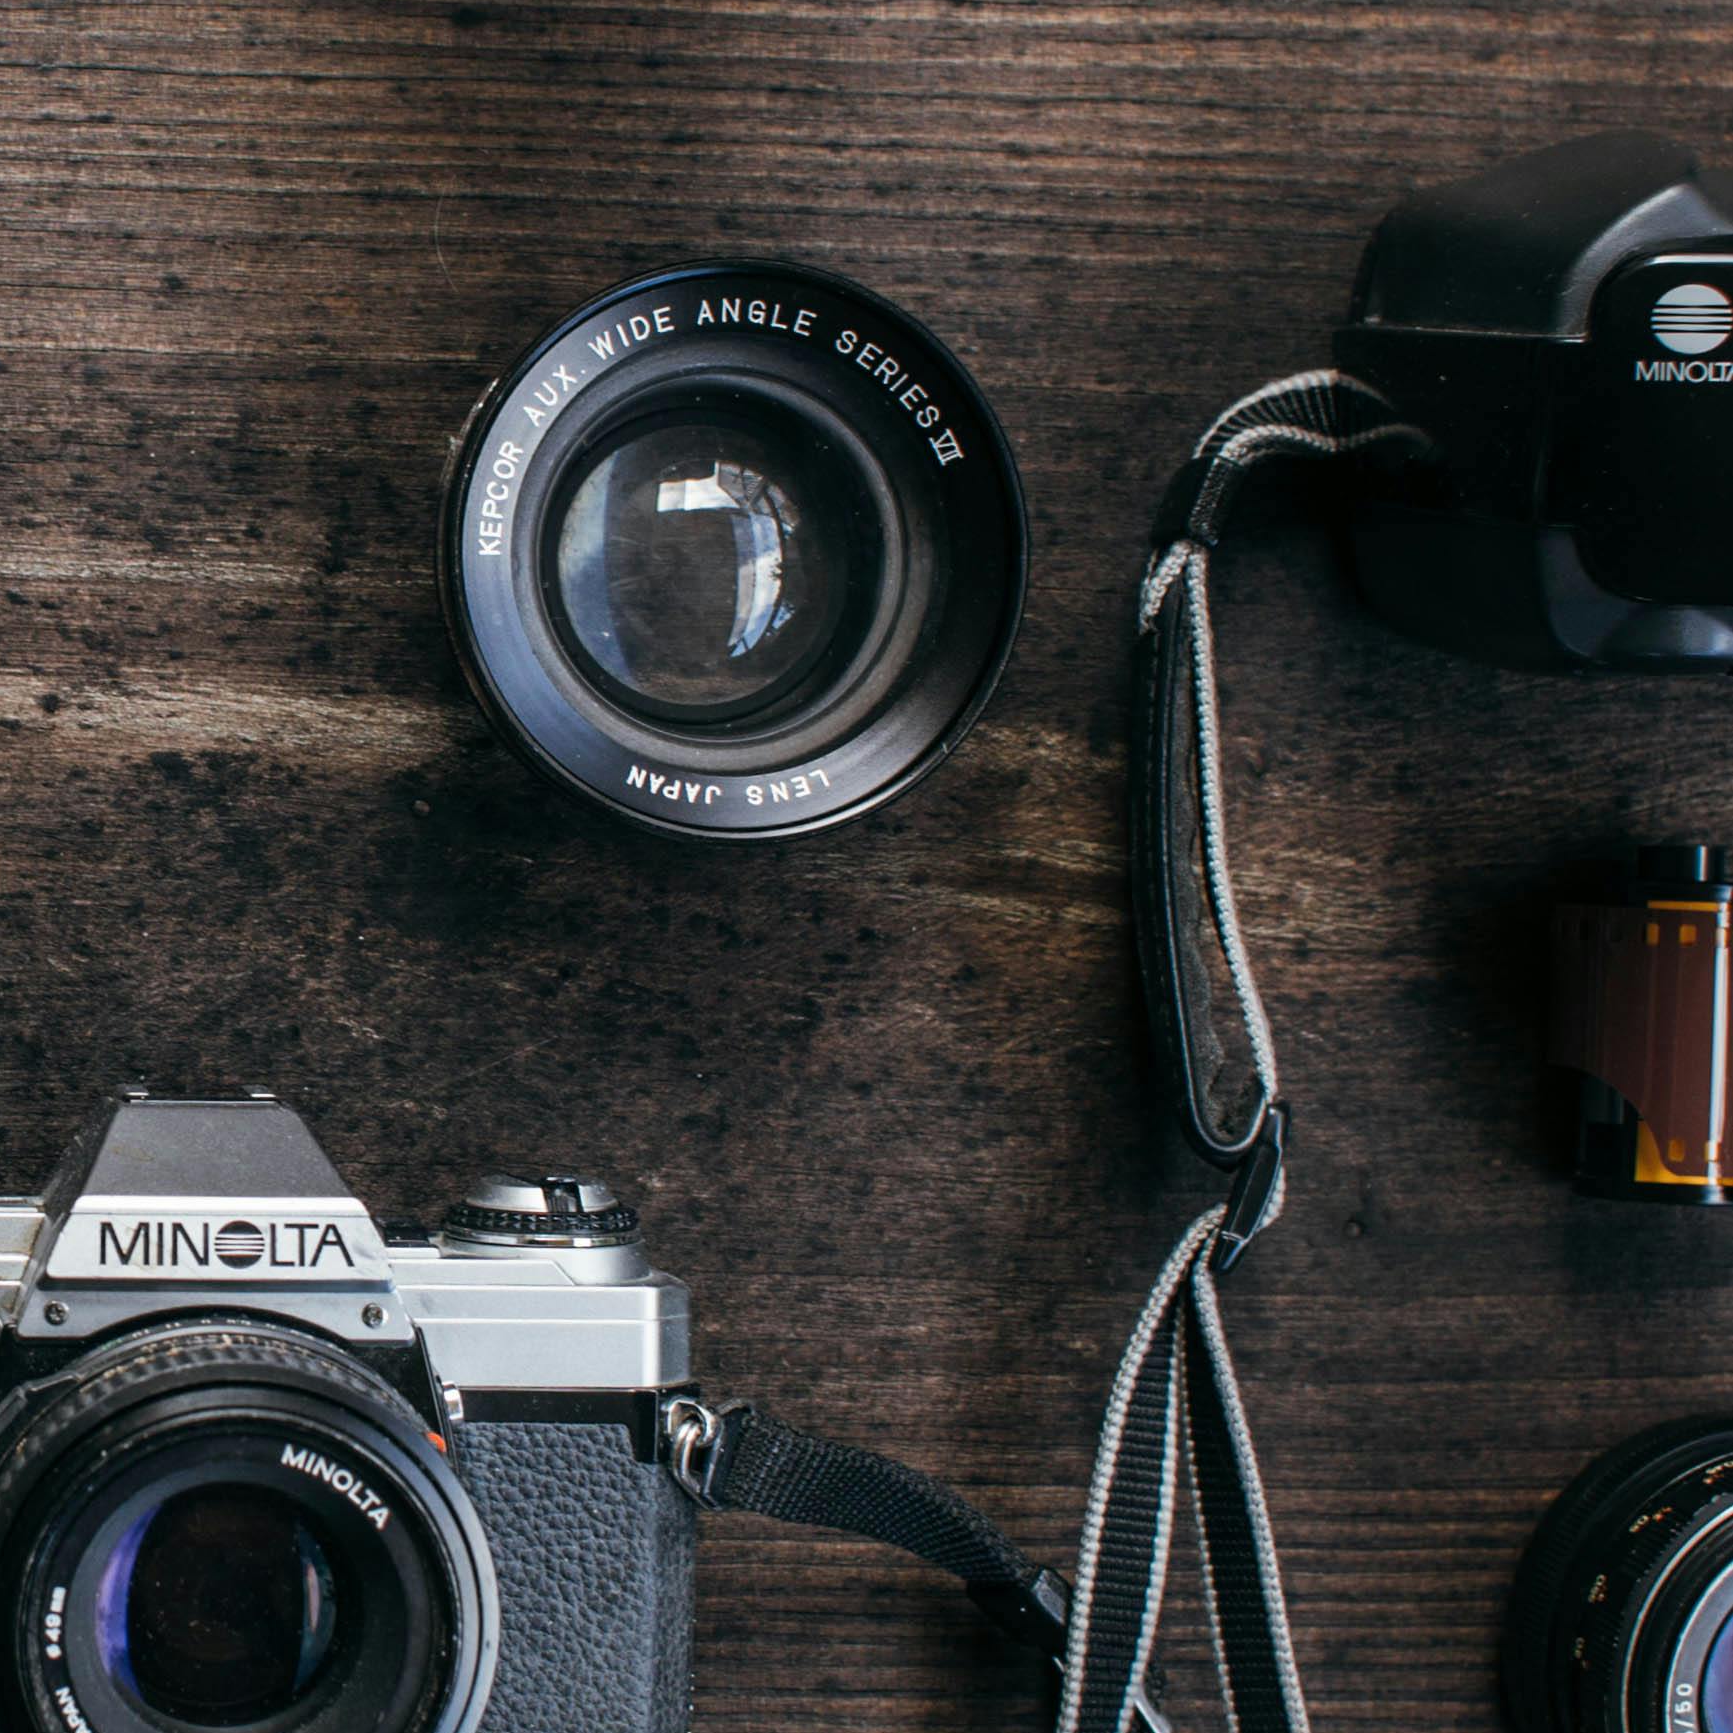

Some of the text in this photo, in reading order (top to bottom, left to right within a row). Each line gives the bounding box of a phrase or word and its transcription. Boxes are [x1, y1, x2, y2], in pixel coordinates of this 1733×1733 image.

[478, 297, 966, 556] KEPCOR AUX. WIDE ANGLE SERIES VII
[626, 764, 831, 806] LENS JAPAN
[99, 1221, 356, 1269] MINOLTA
[280, 1443, 392, 1531] MINOLTA
